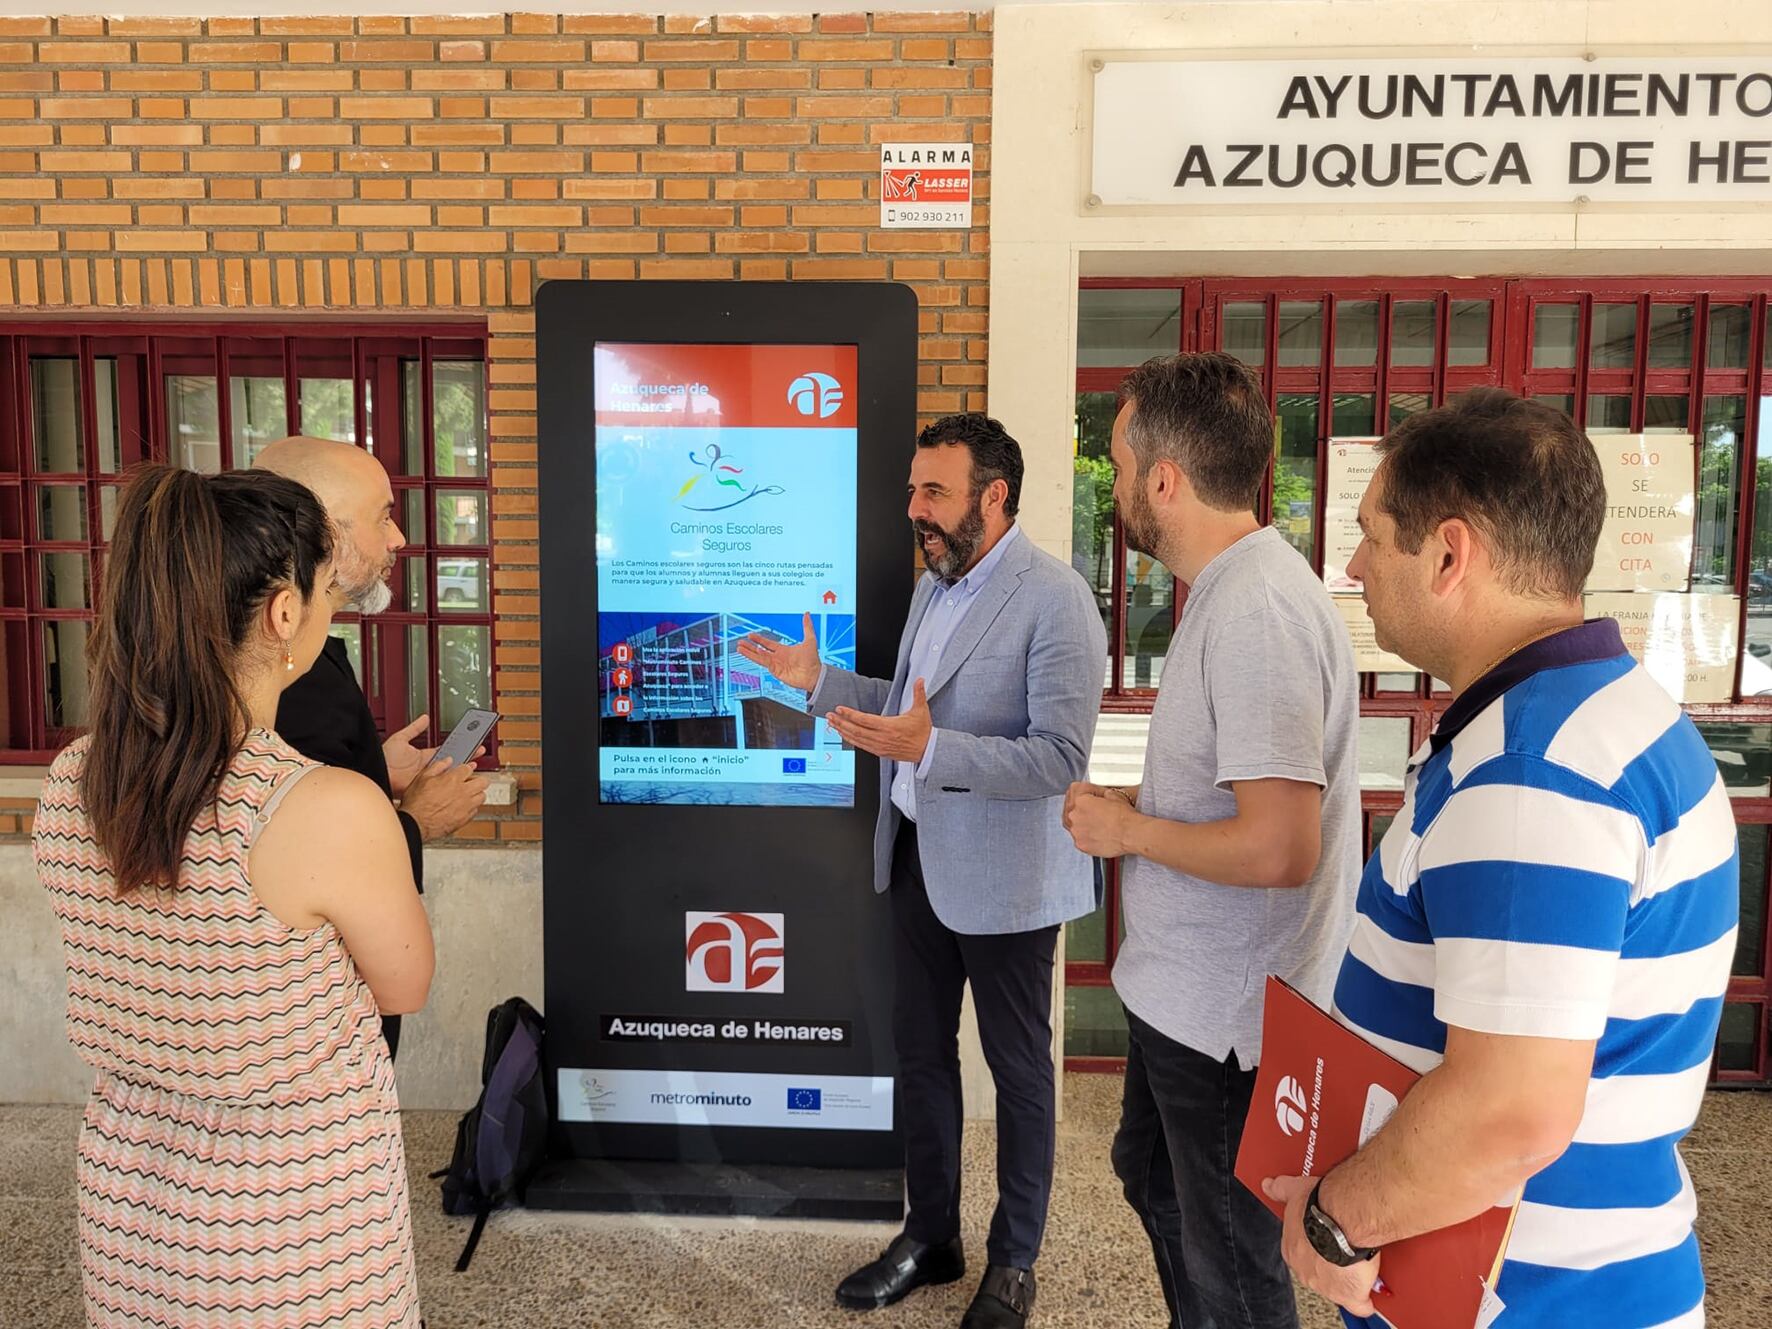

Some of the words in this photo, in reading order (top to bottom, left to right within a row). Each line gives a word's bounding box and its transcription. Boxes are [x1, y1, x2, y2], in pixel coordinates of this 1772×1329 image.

[1276, 72, 1772, 119] AYUNTAMIENTO
[883, 150, 971, 163] ALARMA
[1172, 141, 1532, 188] AZUQUECA
[1567, 140, 1655, 185] DE
[923, 178, 969, 188] LASSER
[900, 211, 920, 221] 902
[922, 211, 943, 222] 930
[944, 212, 964, 222] 211
[610, 382, 685, 397] Azuqueca
[689, 382, 710, 395] de
[610, 400, 673, 413] Henares
[1631, 479, 1649, 492] SE
[1339, 492, 1360, 500] SOLO
[670, 521, 723, 534] Caminos
[726, 522, 784, 535] Escolares
[1620, 532, 1654, 545] CON
[702, 538, 752, 553] Seguros
[625, 560, 659, 568] Caminos
[660, 560, 694, 568] escolares
[797, 562, 834, 570] pensadas
[1619, 558, 1653, 571] CITA
[658, 569, 691, 577] alumnos
[731, 570, 760, 578] lleguen
[782, 570, 814, 578] colegios
[641, 578, 668, 586] segura
[675, 578, 712, 586] saludable
[724, 578, 761, 586] Azuqueca
[613, 754, 641, 763] Pulsa
[657, 754, 667, 763] el
[669, 755, 697, 764] icono
[613, 766, 635, 775] para
[637, 766, 659, 774] más
[661, 765, 722, 775] información
[608, 1017, 715, 1040] Azuqueca
[720, 1020, 749, 1039] de
[754, 1021, 844, 1042] Henares
[650, 1090, 752, 1107] metrominuto
